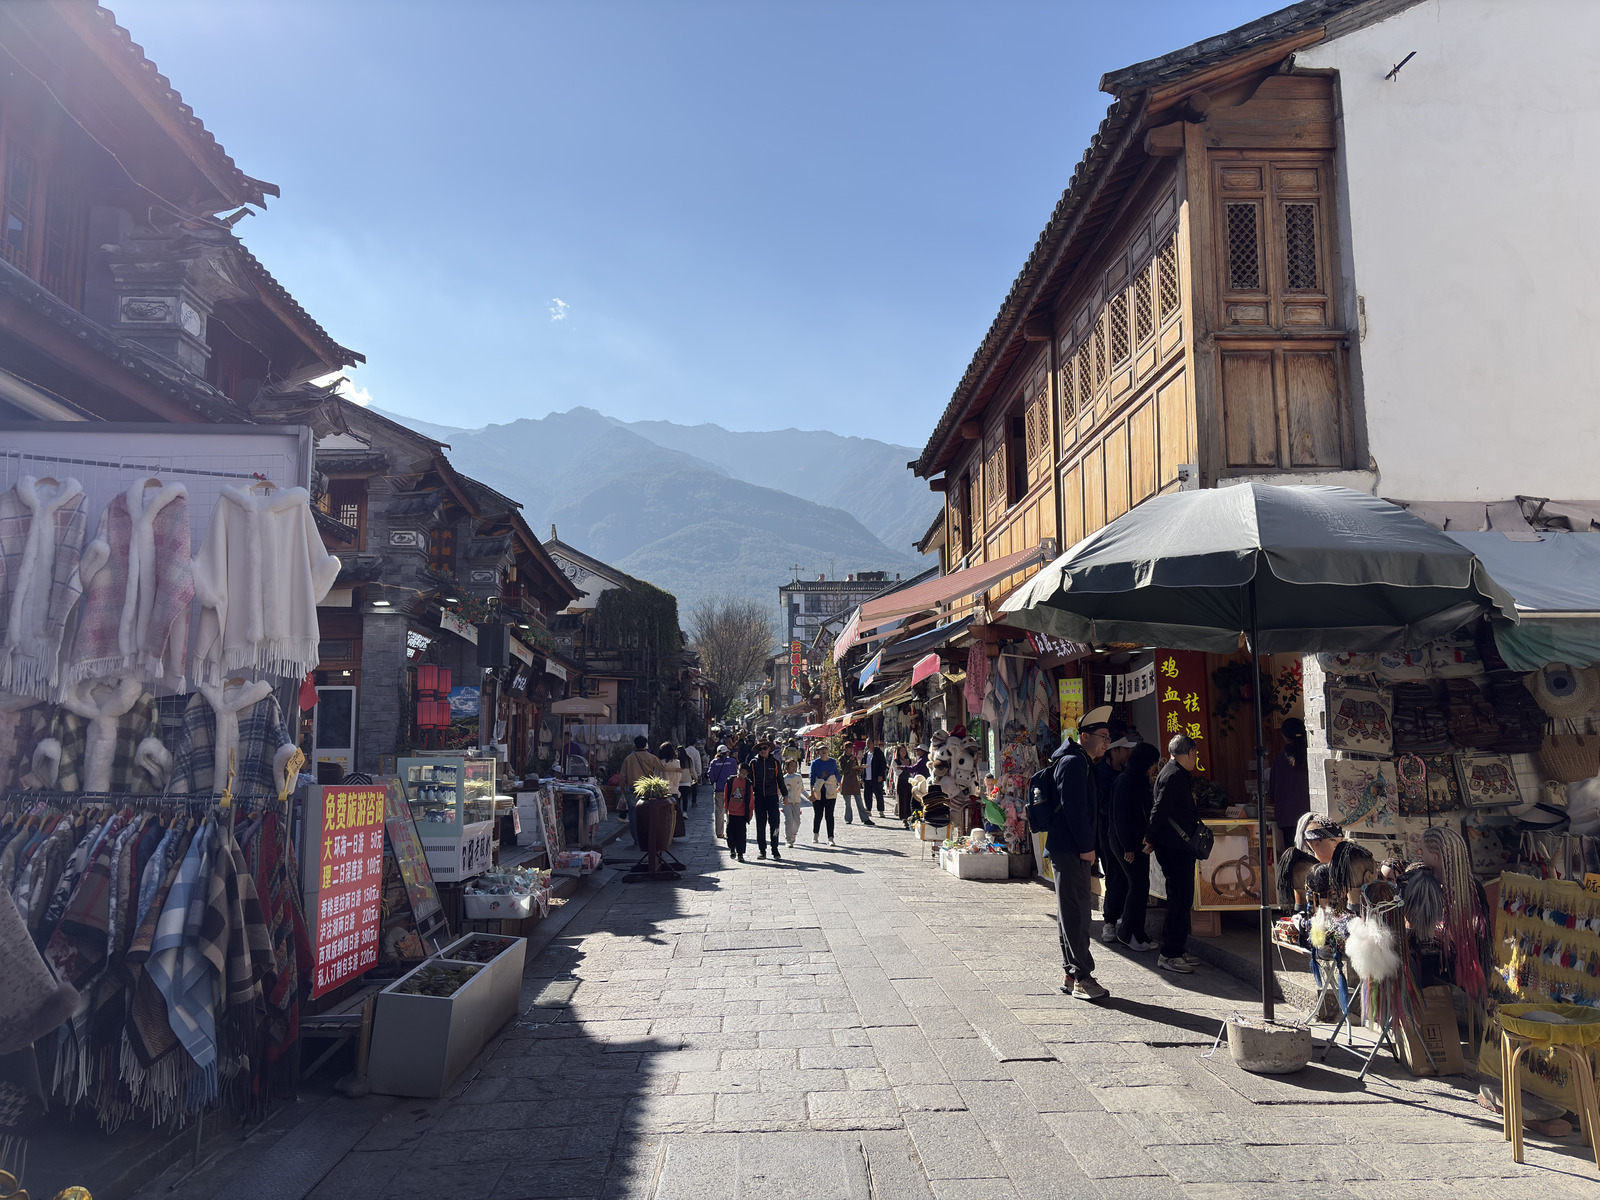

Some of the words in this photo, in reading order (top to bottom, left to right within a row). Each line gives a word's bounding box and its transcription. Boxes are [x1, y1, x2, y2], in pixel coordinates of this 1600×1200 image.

[1160, 656, 1183, 733] 鸡血藤
[325, 792, 384, 831] 免费旅游咨询
[334, 832, 364, 858] 环海一日游
[370, 830, 382, 849] 50元
[322, 836, 333, 890] 大理
[332, 858, 362, 885] 二日深度游
[367, 854, 380, 875] 100元
[321, 888, 361, 919] 香格里拉两日游
[320, 912, 355, 942] 泸沽湖两日游
[318, 931, 359, 966] 西双版纳四日游
[317, 952, 358, 988] 私人订制包车游
